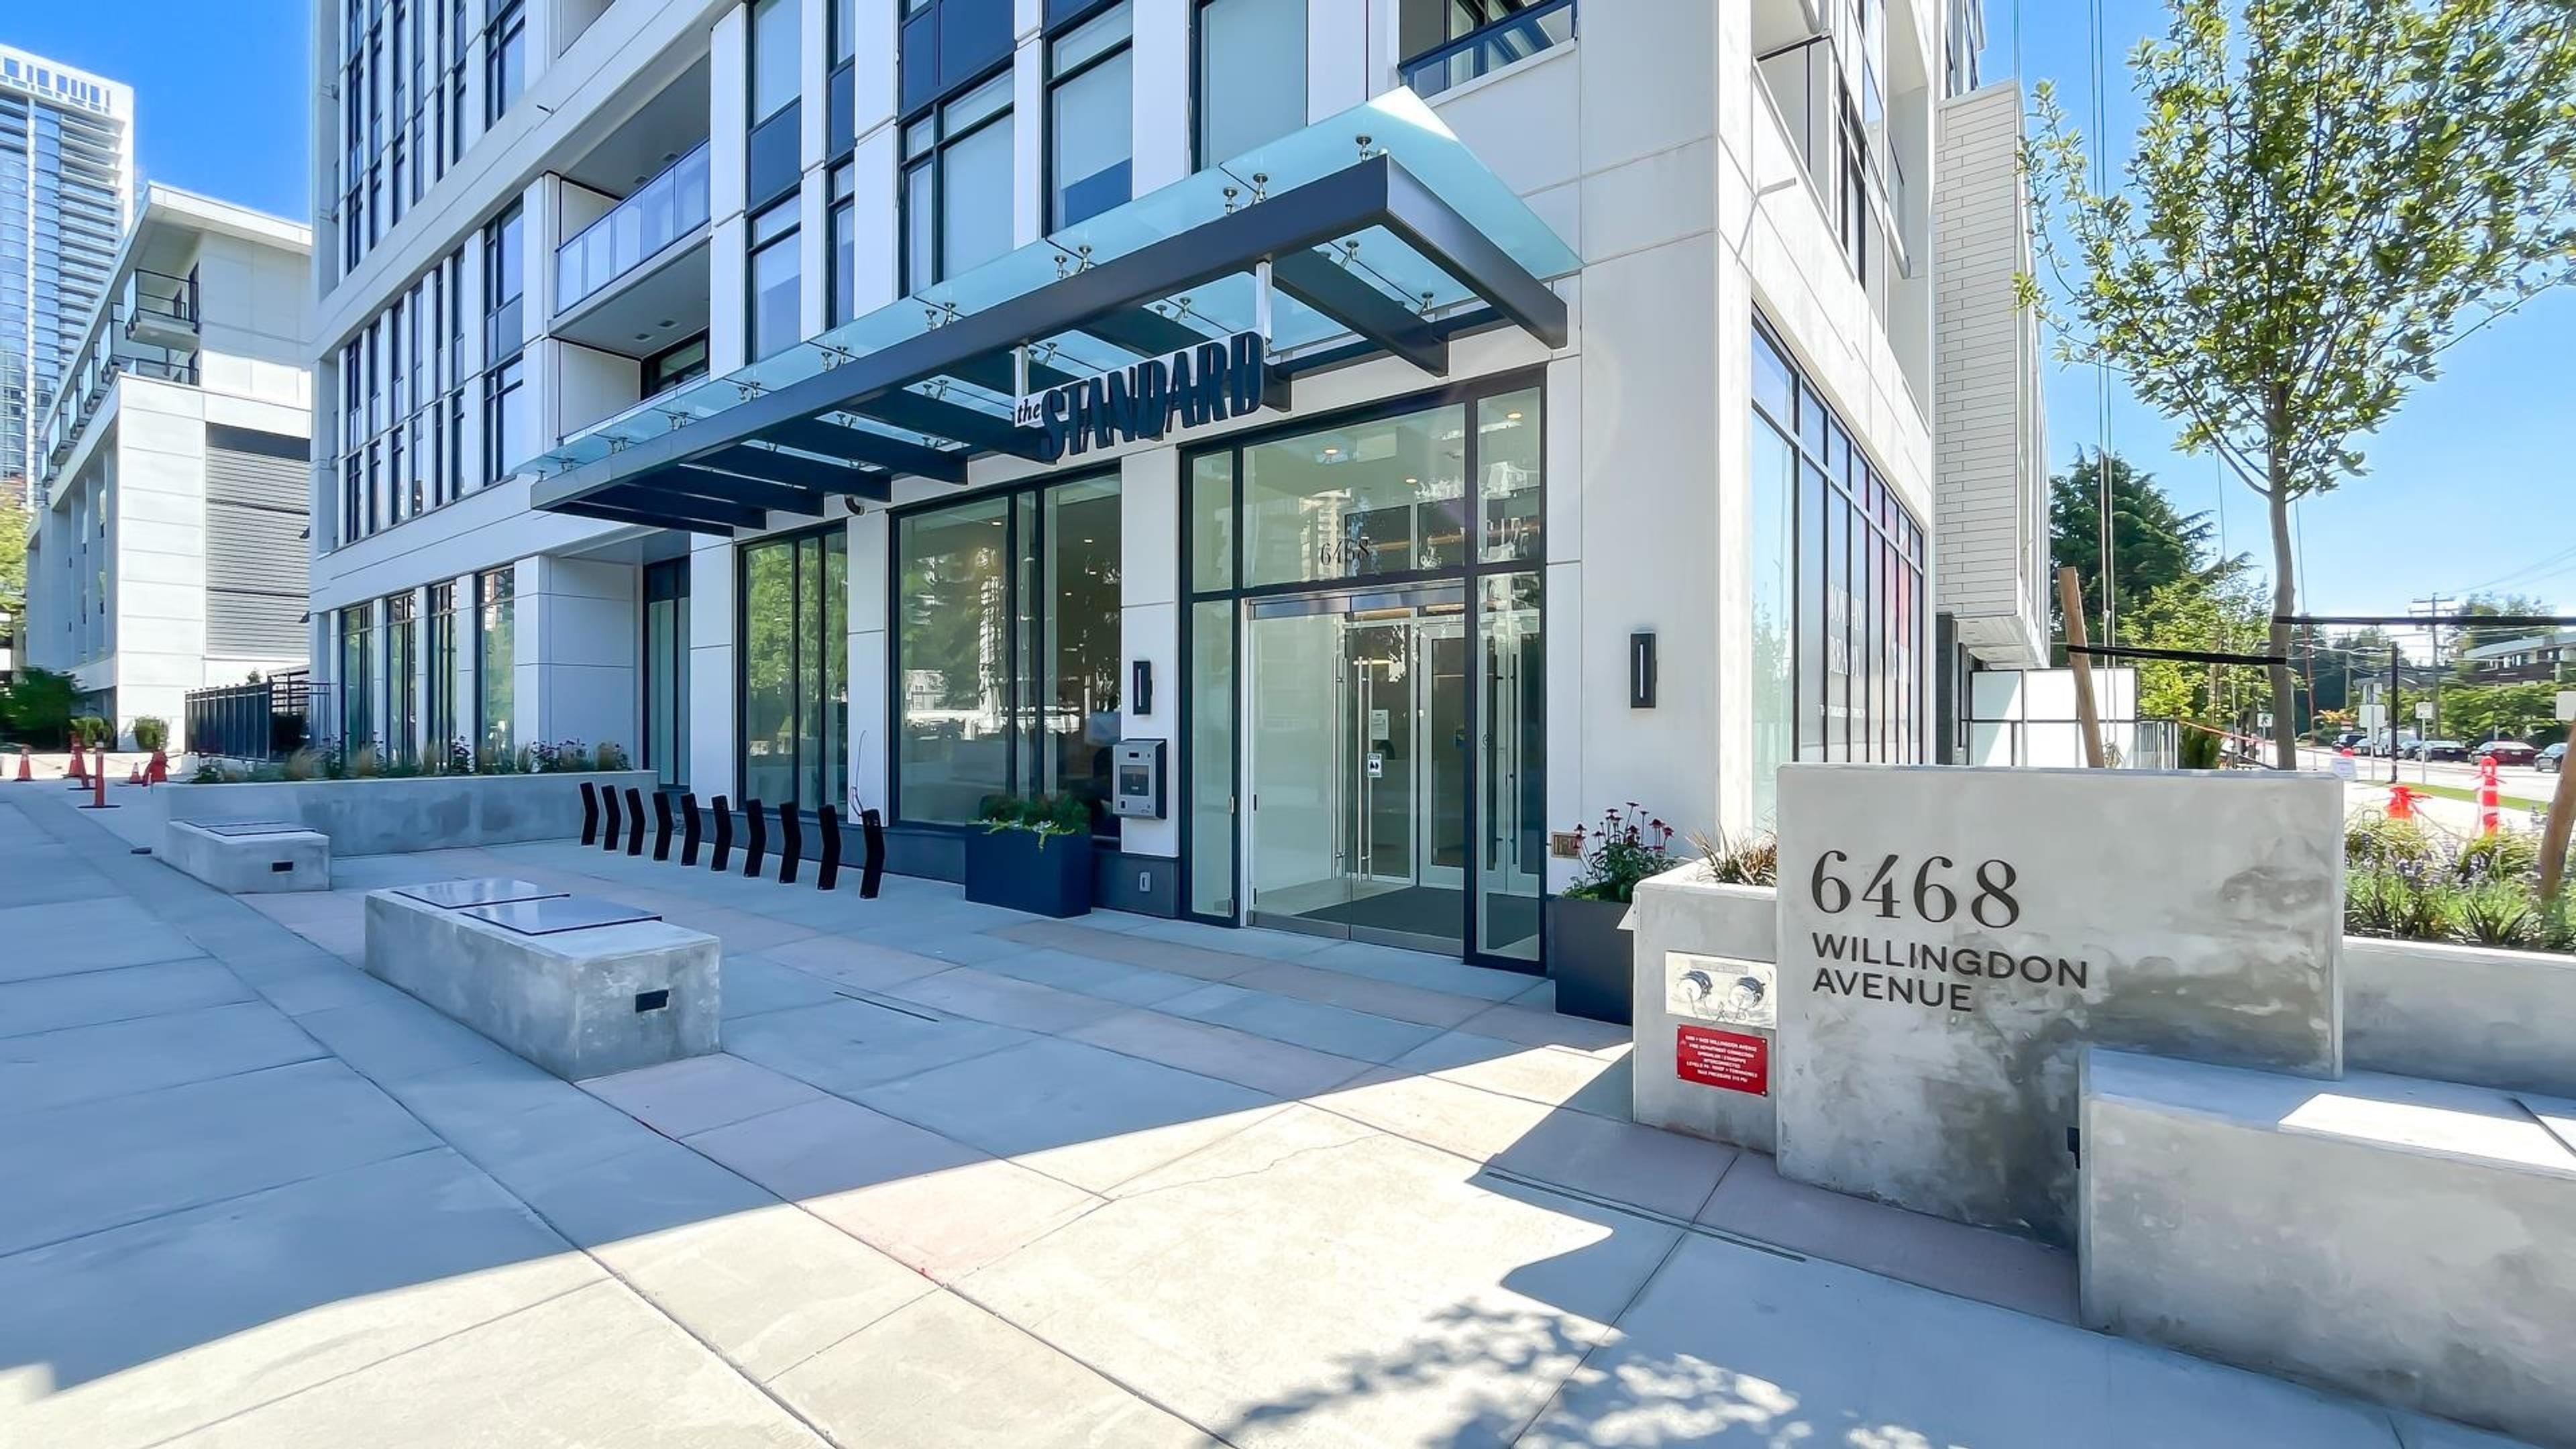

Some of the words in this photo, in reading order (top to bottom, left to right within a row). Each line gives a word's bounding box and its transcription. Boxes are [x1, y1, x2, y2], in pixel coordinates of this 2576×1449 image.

[1017, 396, 1040, 424] the
[1040, 331, 1265, 464] STANDARD
[1811, 850, 2020, 928] 6468
[1812, 932, 2088, 989] WILLINGDON
[1812, 967, 1973, 1012] AVENUE
